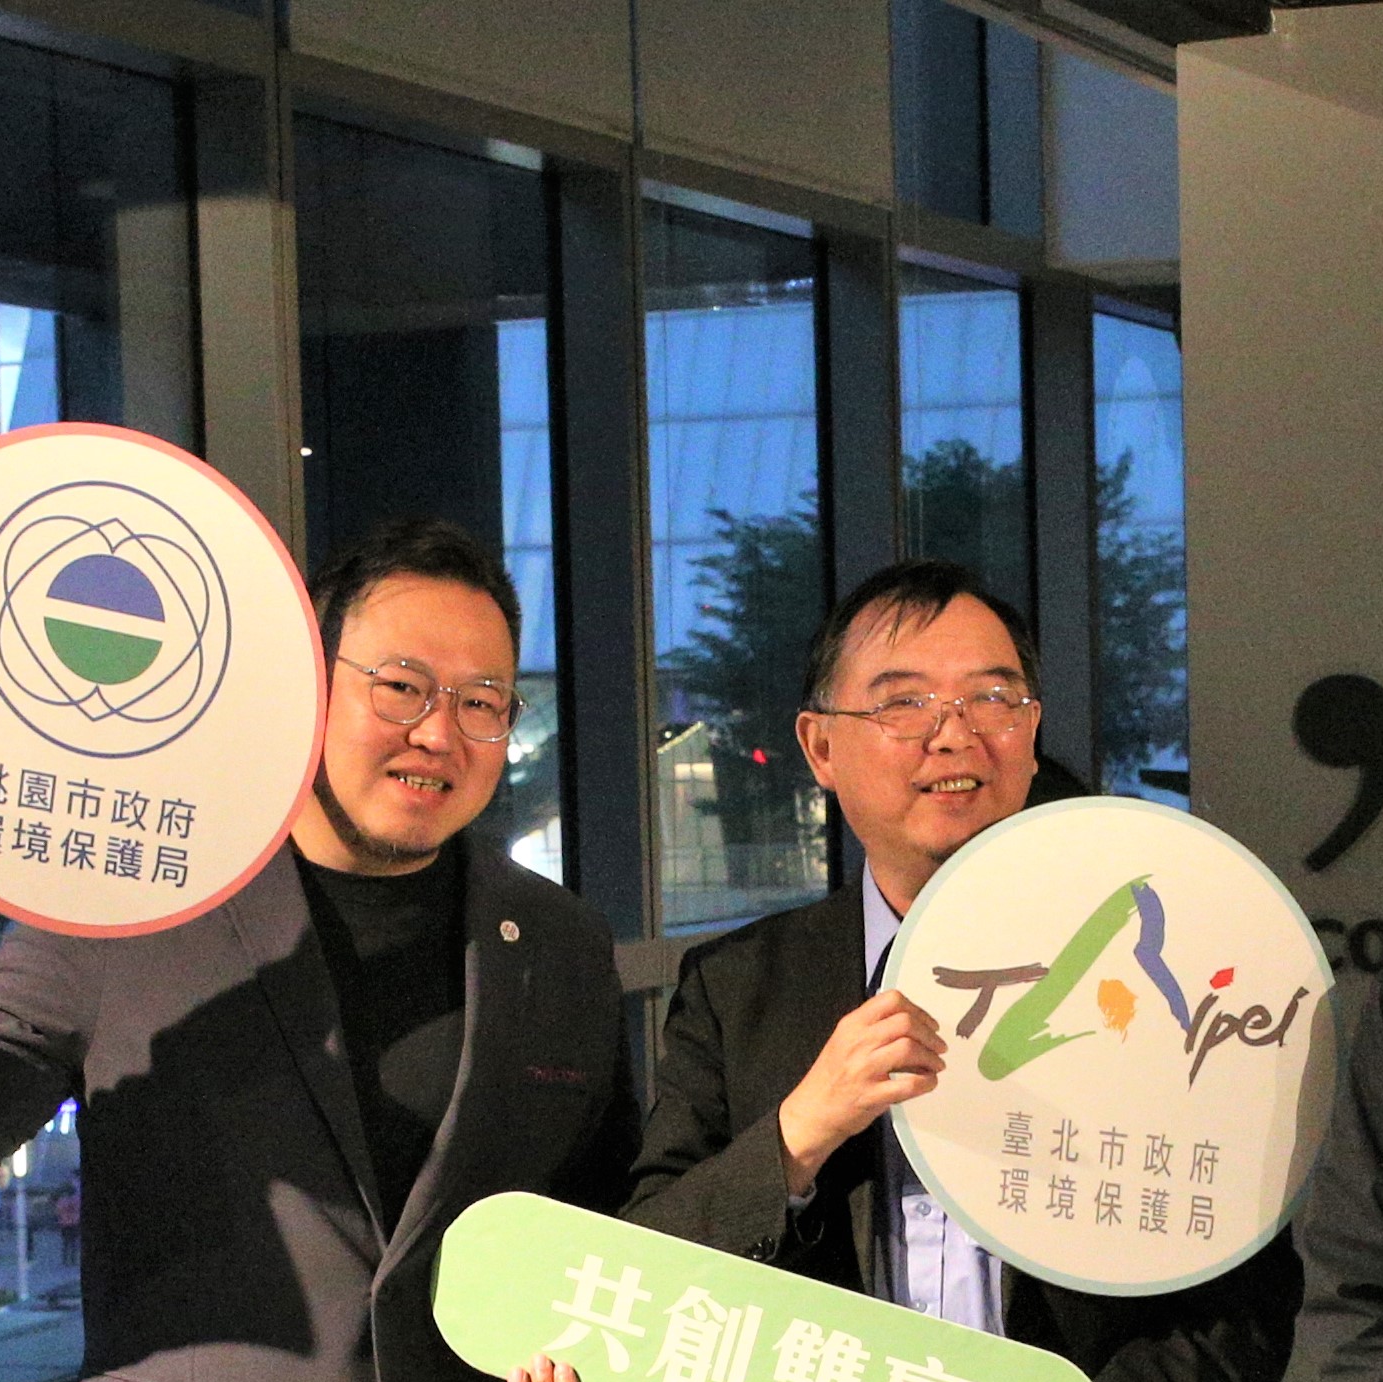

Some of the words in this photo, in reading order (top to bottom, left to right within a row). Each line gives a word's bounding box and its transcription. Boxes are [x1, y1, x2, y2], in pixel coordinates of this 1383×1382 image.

[1001, 1111, 1220, 1184] 臺北市政府
[998, 1168, 1216, 1240] 環境保護局
